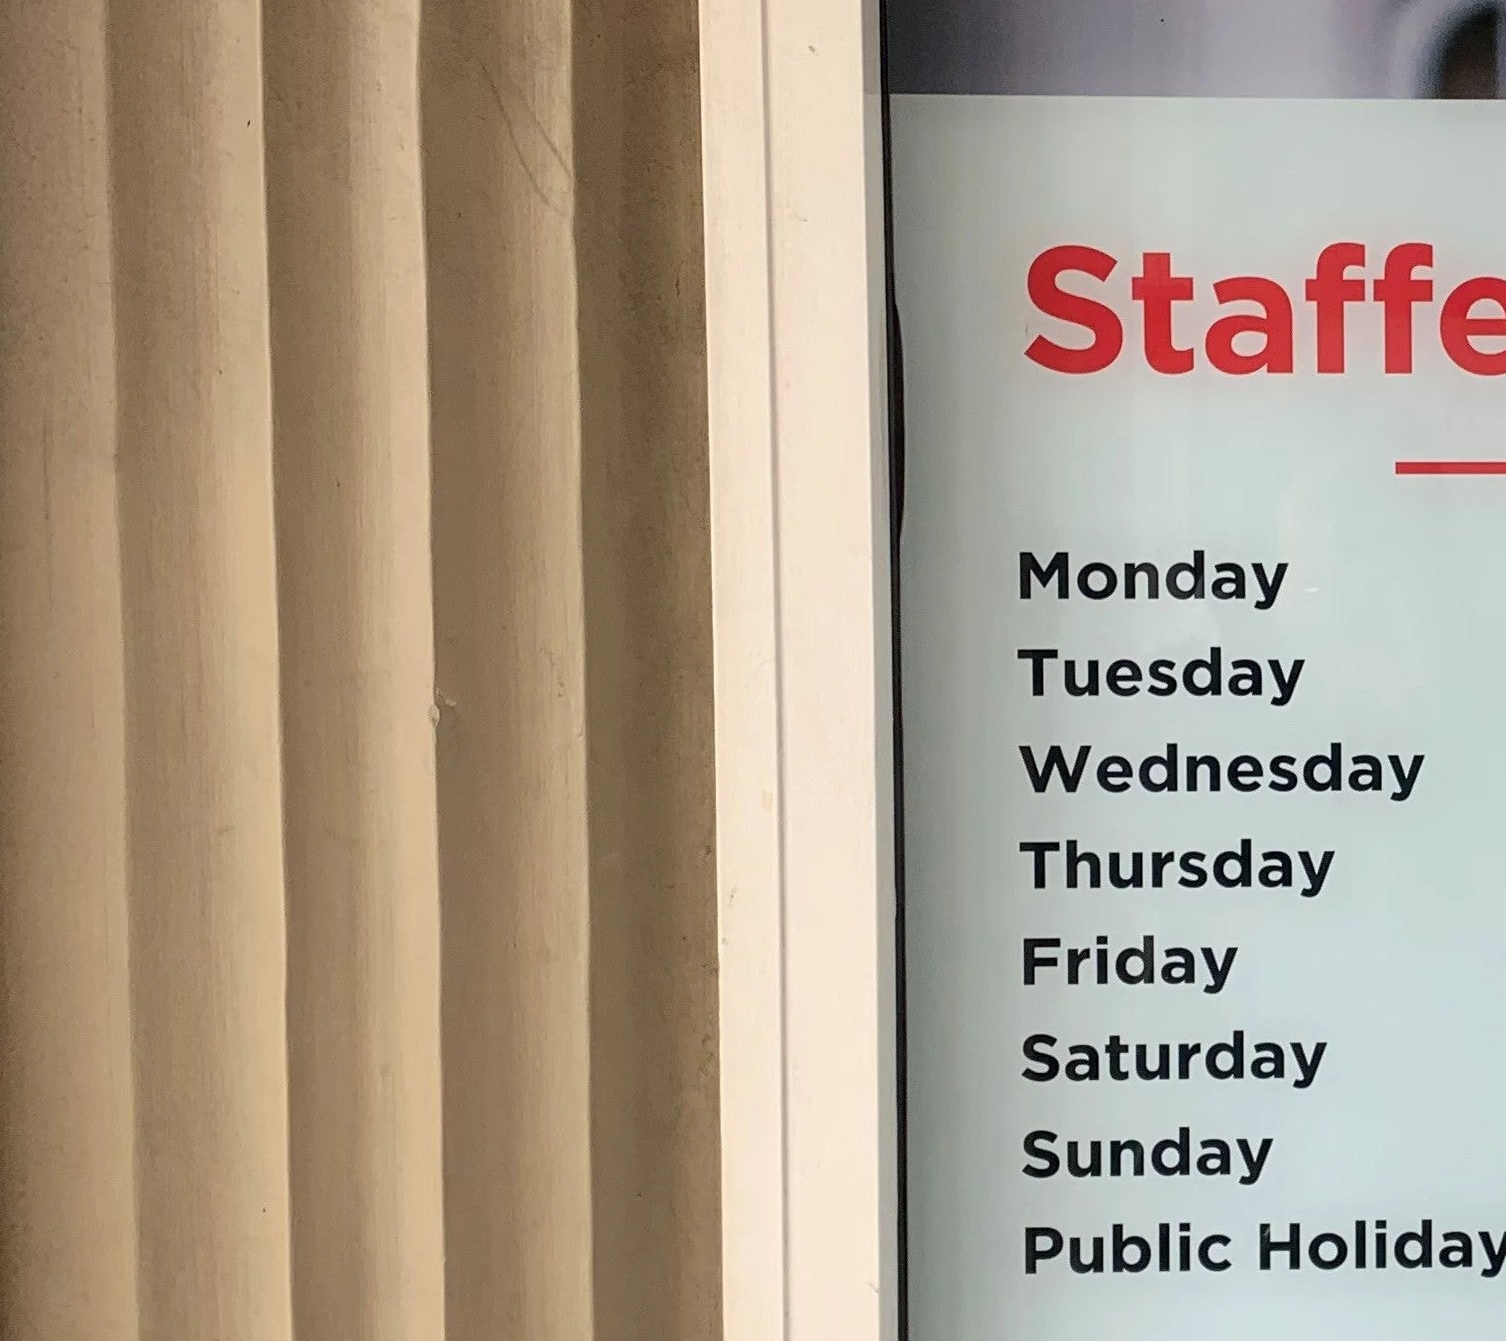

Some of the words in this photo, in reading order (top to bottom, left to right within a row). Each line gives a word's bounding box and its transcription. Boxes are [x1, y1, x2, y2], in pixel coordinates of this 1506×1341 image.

[1019, 550, 1289, 610] Monday
[1017, 646, 1305, 706] Tuesday
[1018, 742, 1425, 802] Wednesday
[1019, 838, 1335, 898] Thursday
[1024, 935, 1238, 994] Friday
[1021, 1030, 1327, 1089] Saturday
[1022, 1127, 1274, 1185] Sunday
[1025, 1222, 1232, 1274] Public
